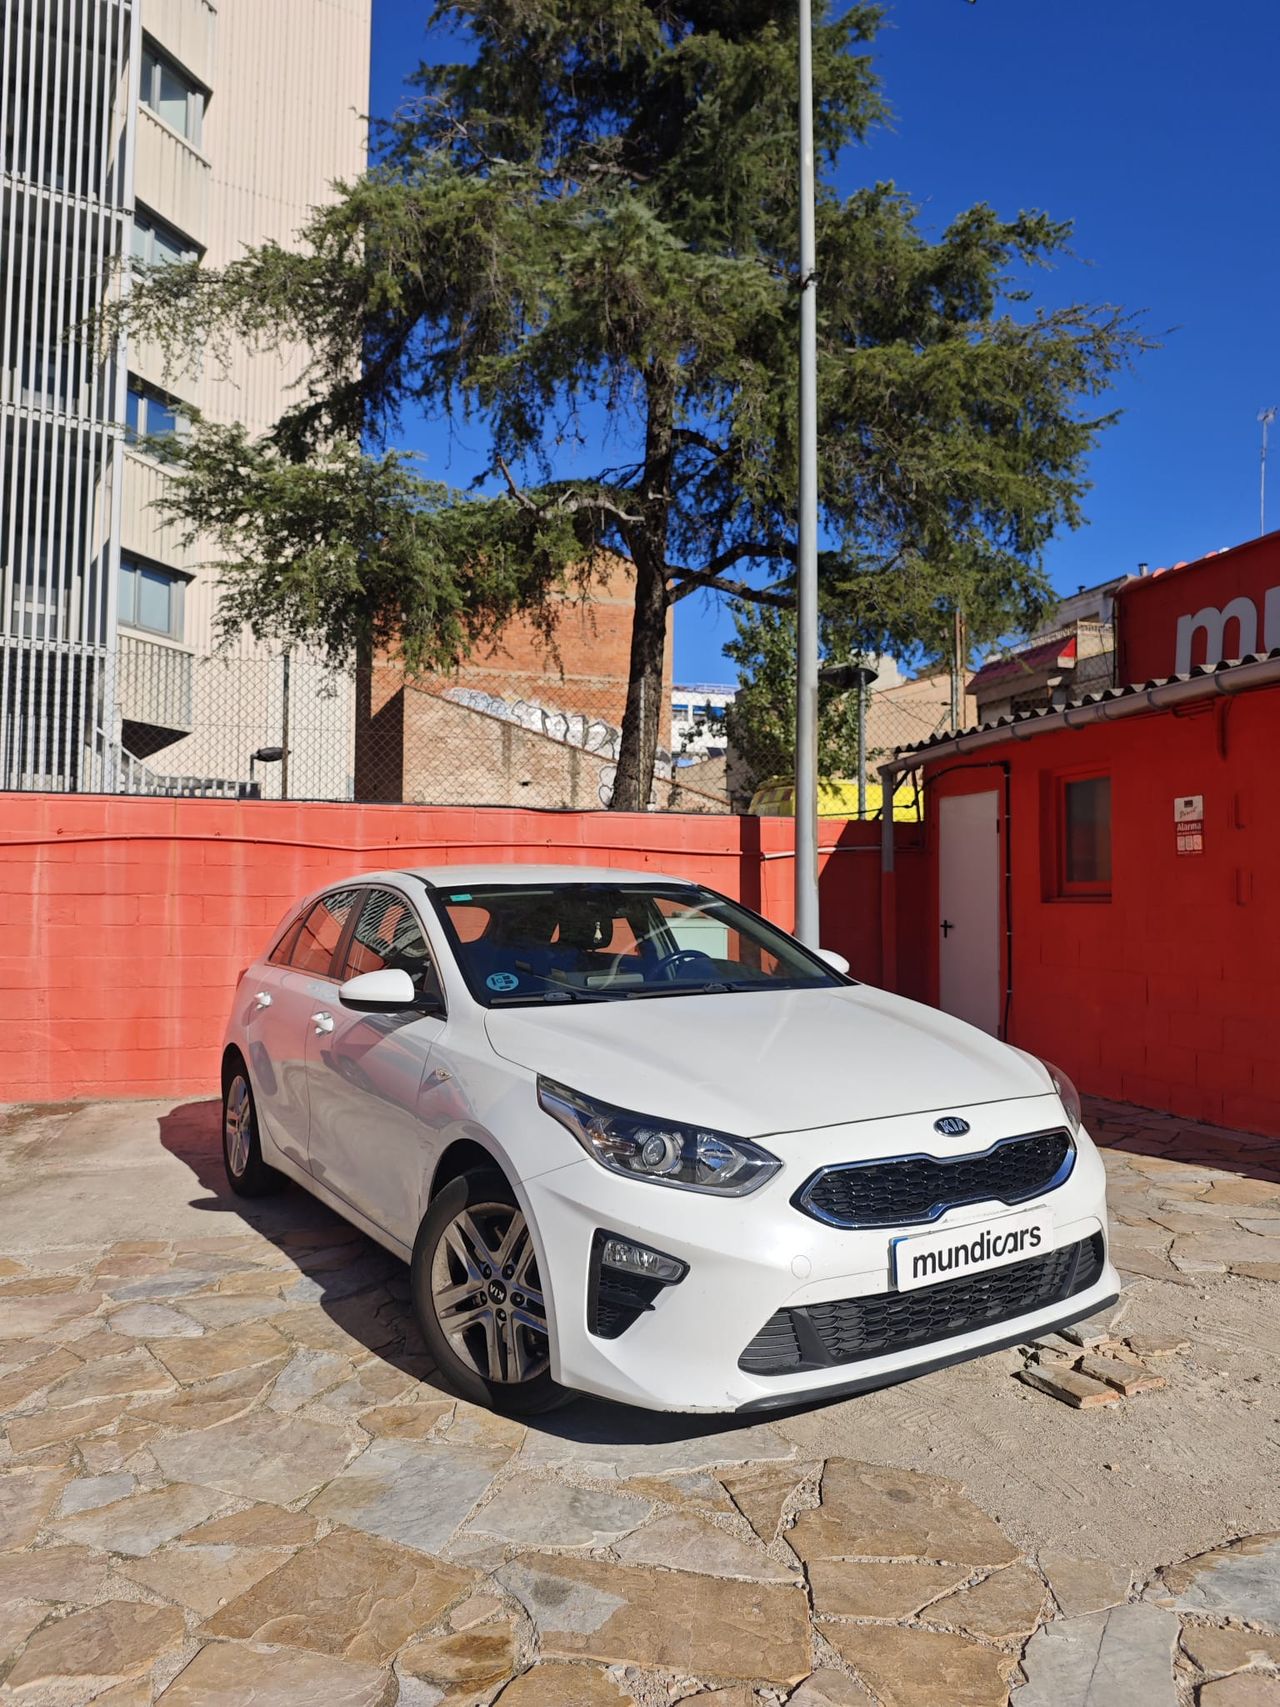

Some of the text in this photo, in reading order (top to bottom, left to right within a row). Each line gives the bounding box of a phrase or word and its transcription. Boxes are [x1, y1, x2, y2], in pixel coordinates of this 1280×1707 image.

[1177, 822, 1202, 832] Alarma
[939, 1118, 968, 1133] KIA
[913, 1226, 1042, 1279] mundicars
[490, 1284, 504, 1300] KIA
